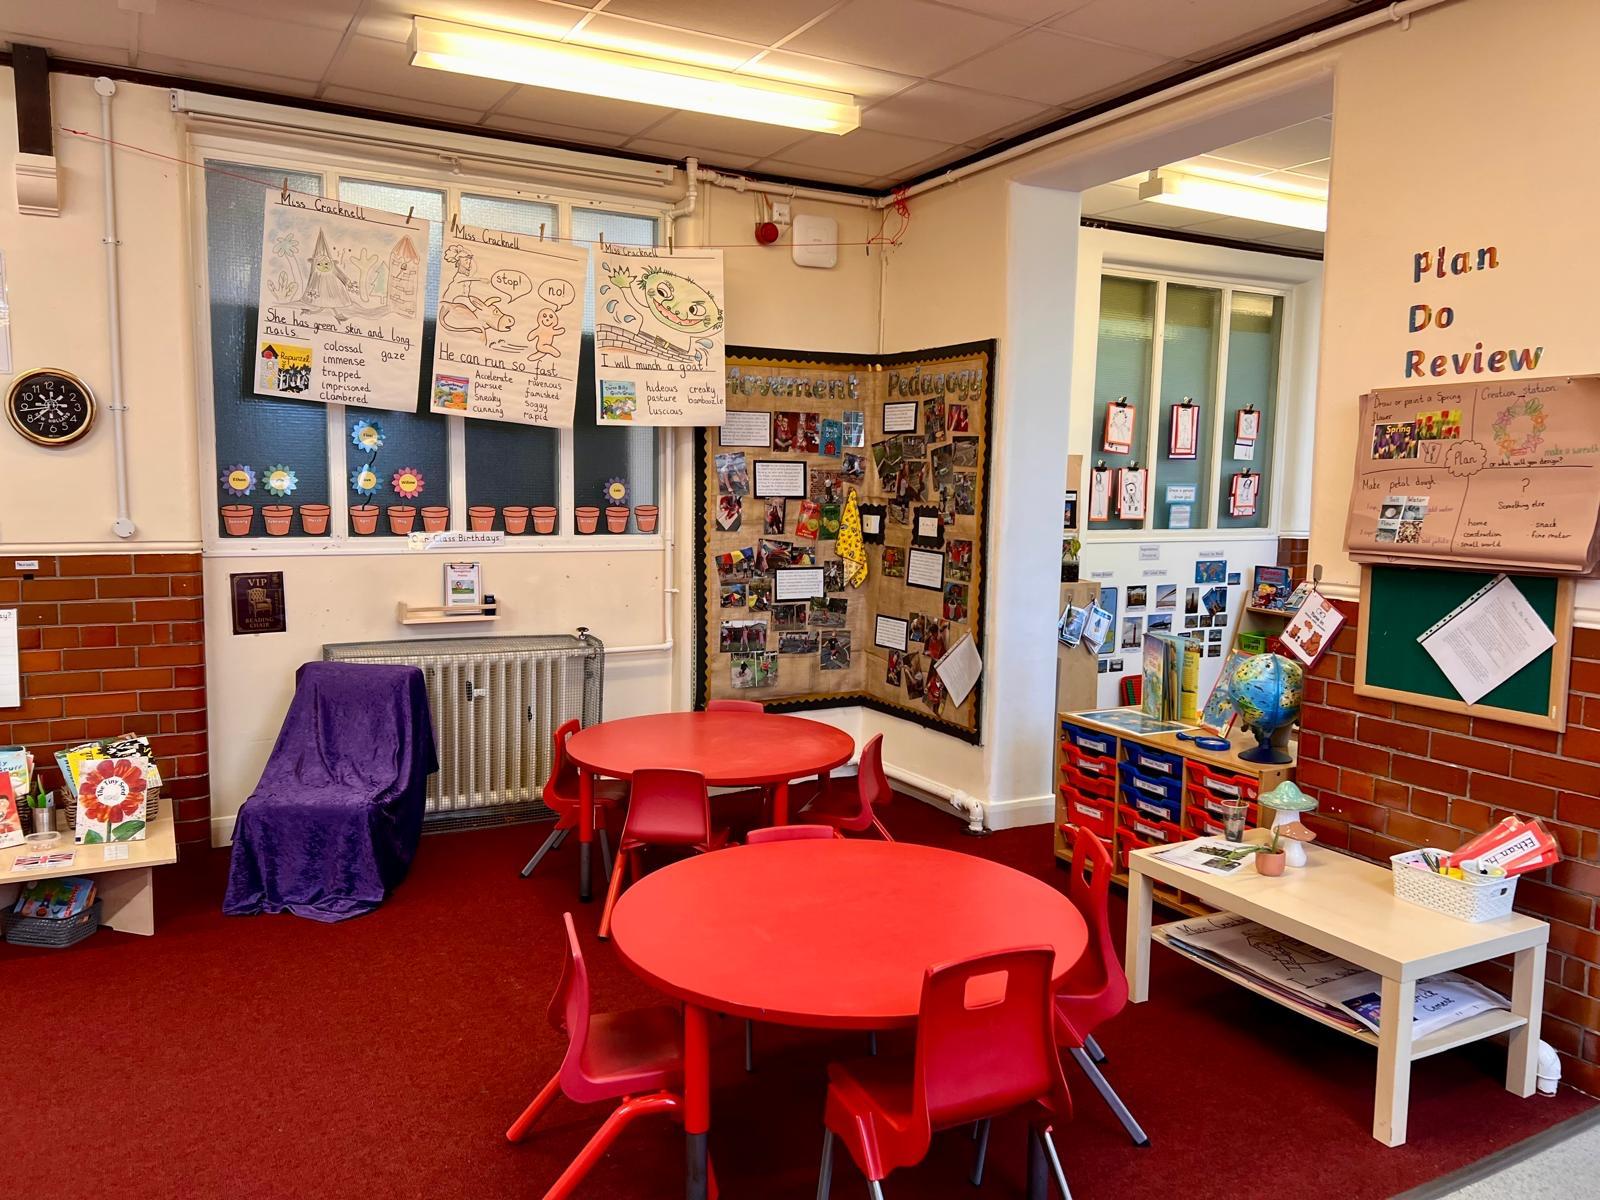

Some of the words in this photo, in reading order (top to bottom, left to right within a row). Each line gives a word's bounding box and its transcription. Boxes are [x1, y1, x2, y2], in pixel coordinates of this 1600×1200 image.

[281, 192, 305, 208] Miss
[314, 199, 365, 220] Cracknell
[455, 224, 477, 241] Miss
[482, 229, 520, 250] Cracknell
[605, 244, 620, 254] Miss
[623, 247, 658, 257] Cracknell
[549, 284, 565, 296] no!
[1409, 304, 1454, 333] Do
[266, 308, 286, 324] She
[293, 315, 309, 328] has
[313, 320, 337, 334] green
[345, 323, 362, 335] skin
[368, 326, 384, 339] and
[392, 328, 411, 350] long
[266, 325, 296, 337] nails
[324, 341, 363, 354] colossal
[381, 350, 405, 361] gaze
[323, 355, 365, 367] immense
[439, 343, 454, 361] He
[460, 353, 479, 365] can
[484, 356, 505, 369] run
[512, 361, 526, 371] so
[534, 360, 557, 379] fast
[601, 353, 608, 367] I
[614, 355, 629, 369] will
[635, 359, 661, 371] munch
[1405, 342, 1545, 378] Review
[322, 367, 361, 380] trapped
[475, 370, 513, 383] Accelerate
[32, 385, 40, 393] 11
[44, 381, 54, 390] 12
[321, 381, 371, 393] imprisoned
[474, 382, 503, 393] pursue
[528, 379, 562, 390] ravenous
[646, 381, 678, 392] hideous
[689, 382, 717, 398] creaky
[22, 393, 33, 401] 10
[69, 393, 76, 401] 2
[525, 388, 560, 400] famished
[1480, 386, 1516, 400] Creation
[646, 393, 677, 406] pasture
[687, 394, 724, 405] bamboozle
[1374, 397, 1392, 408] Draw
[1404, 395, 1424, 408] paint
[1437, 391, 1462, 404] Spring
[74, 403, 81, 411] 3
[473, 406, 504, 418] cunning
[524, 401, 548, 414] soggy
[648, 405, 683, 415] luscious
[27, 414, 33, 422] 8
[523, 410, 549, 421] rapid
[62, 422, 68, 430] 5
[1386, 425, 1411, 435] Spring
[1454, 450, 1478, 466] Plan
[1362, 478, 1380, 490] Make
[1389, 477, 1410, 493] petal
[1521, 477, 1531, 493] ?
[1467, 518, 1488, 526] home
[1536, 518, 1557, 528] snack
[248, 578, 267, 587] VIP
